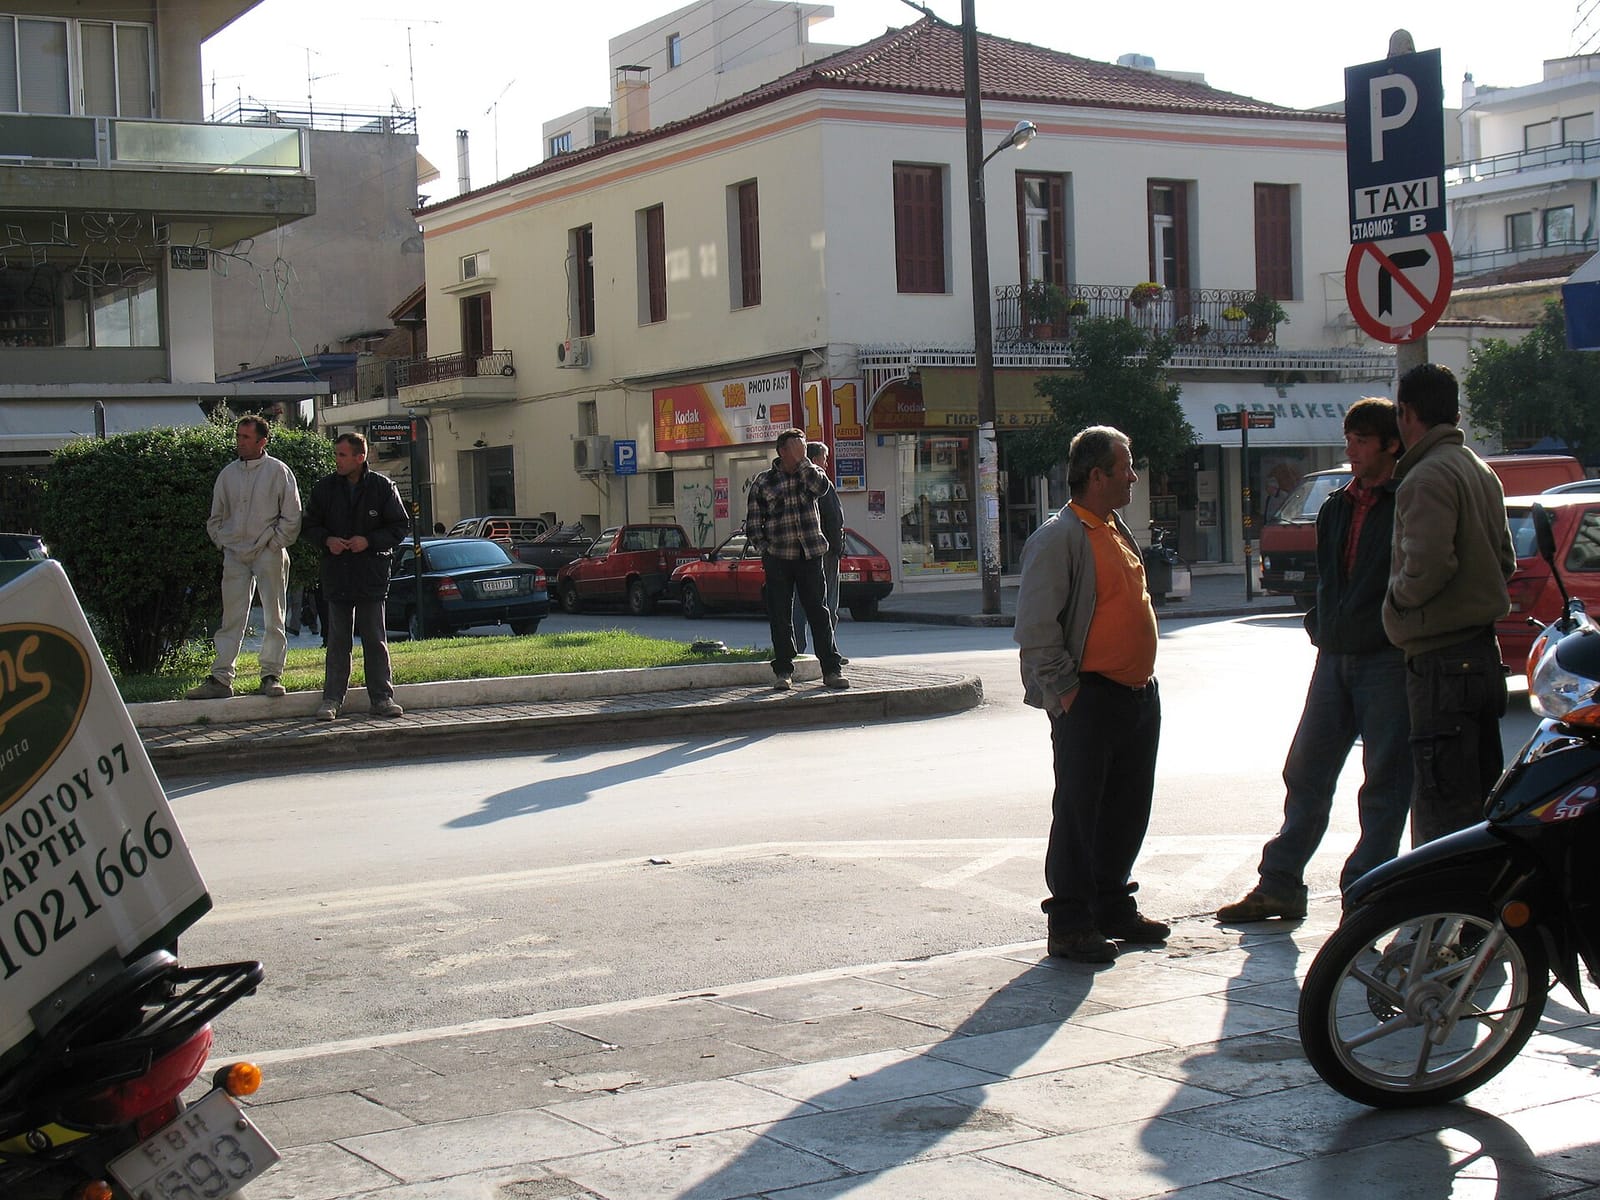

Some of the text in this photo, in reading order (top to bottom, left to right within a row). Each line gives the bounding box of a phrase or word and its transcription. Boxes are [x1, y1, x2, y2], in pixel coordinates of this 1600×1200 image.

[1369, 73, 1418, 163] P
[1364, 181, 1428, 214] TAXI
[1352, 218, 1393, 240] ΣΤΑΘΜΟΣ
[748, 375, 789, 394] PHOTO FAST
[675, 409, 699, 425] Kodak
[897, 402, 923, 412] Koda
[619, 446, 633, 466] P
[0, 743, 131, 862] ΛΟΓΟΥ 97
[0, 818, 86, 906] ΑΡΤΗ
